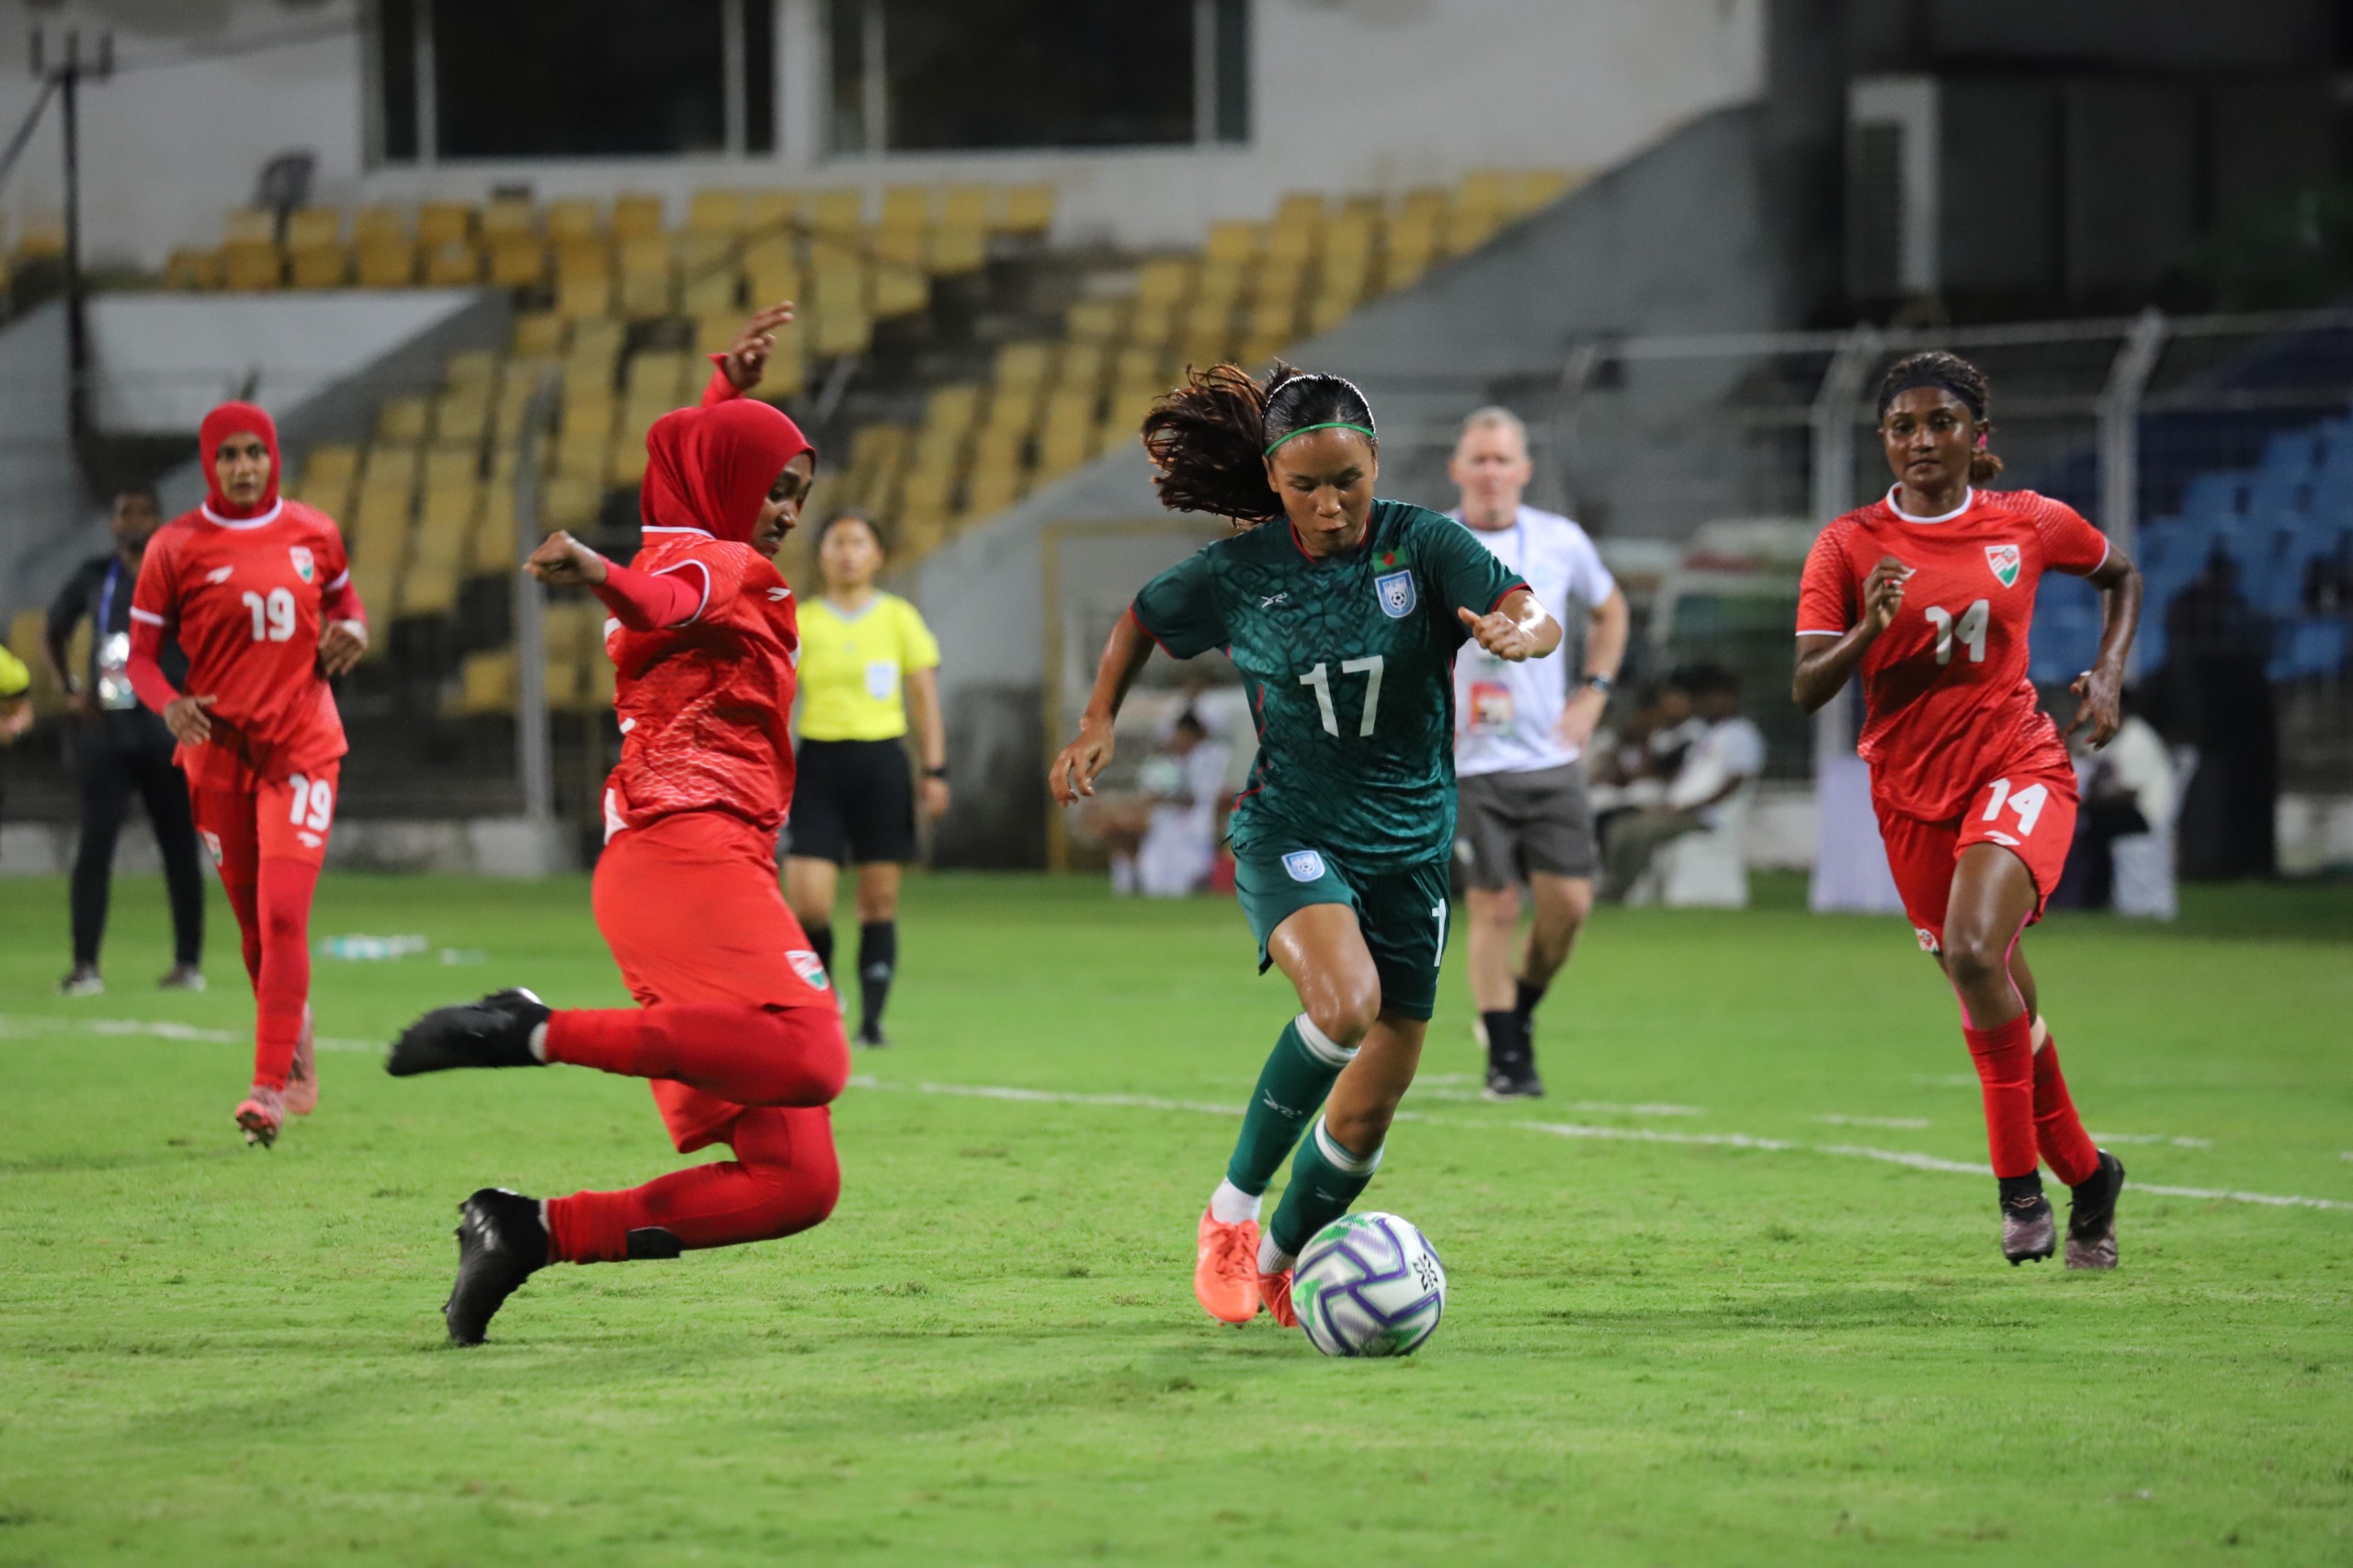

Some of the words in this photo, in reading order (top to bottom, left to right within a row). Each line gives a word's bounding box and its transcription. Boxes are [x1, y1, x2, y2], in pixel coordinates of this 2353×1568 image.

[243, 587, 296, 642] 19
[1925, 599, 1989, 664] 14
[1299, 654, 1384, 738] 17
[290, 774, 332, 832] 19
[1982, 778, 2048, 836] 14
